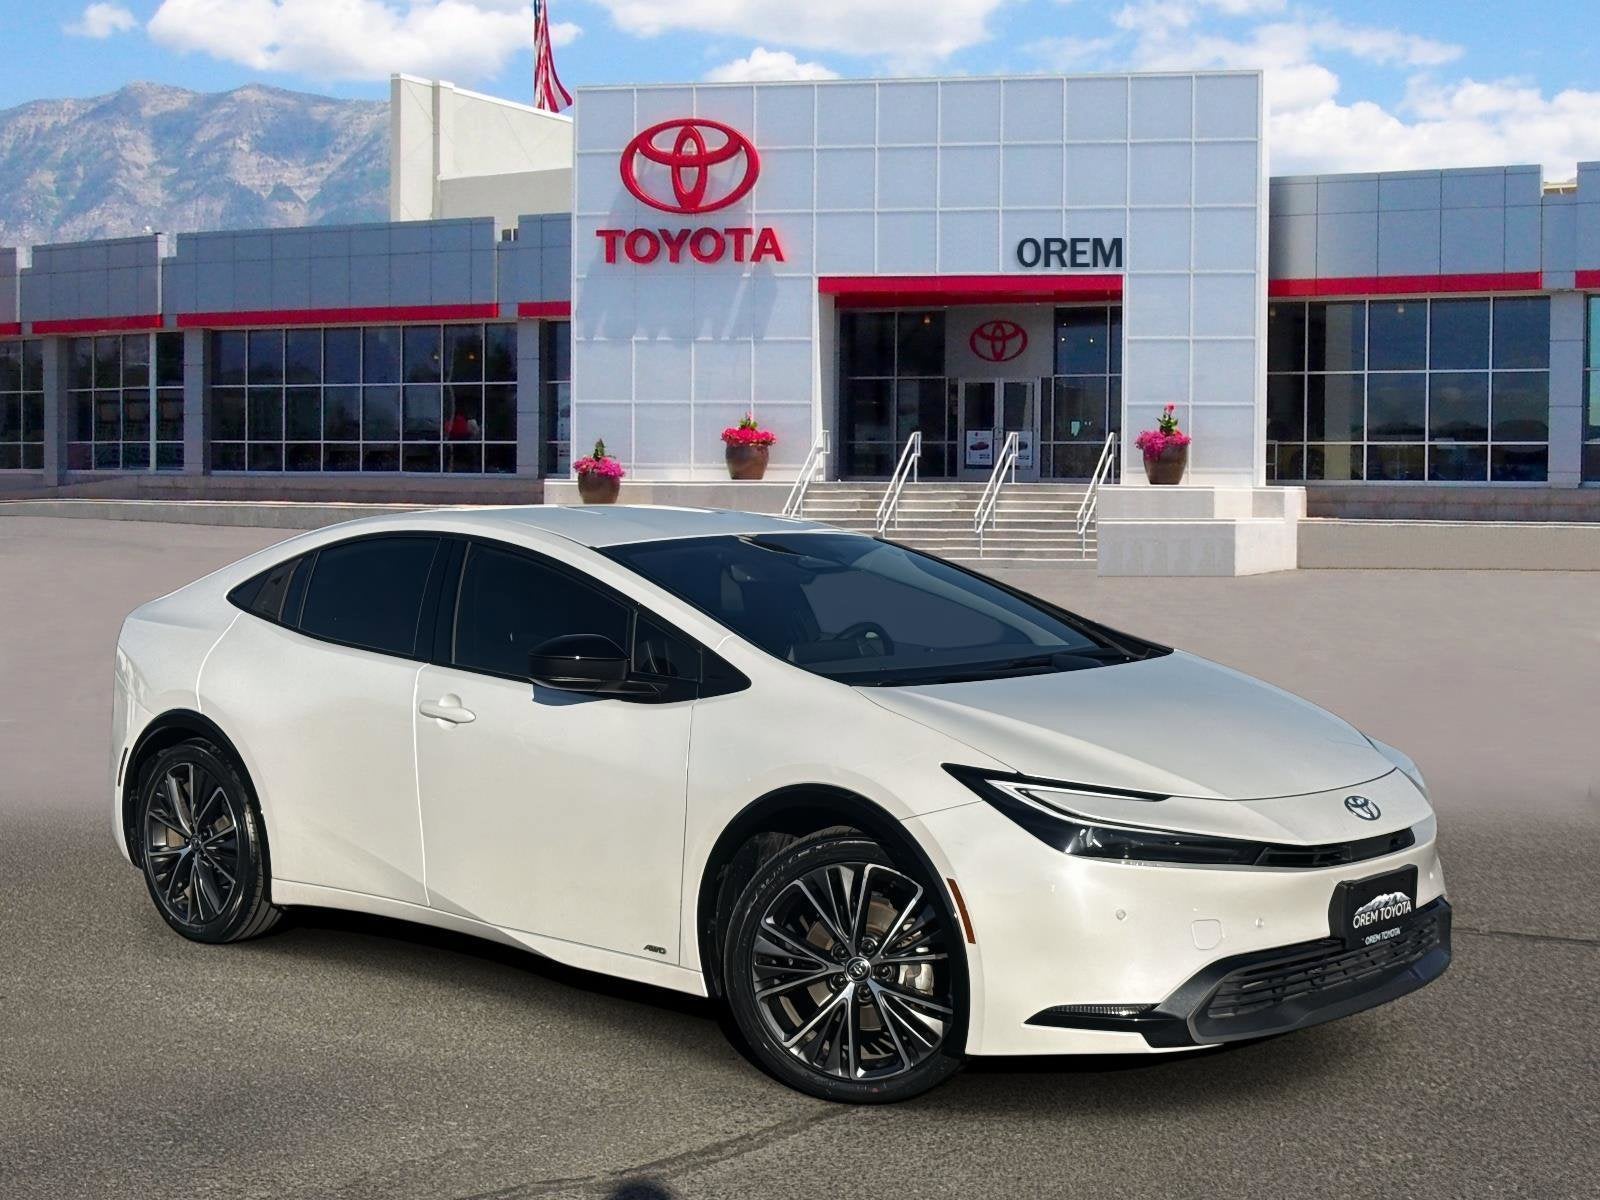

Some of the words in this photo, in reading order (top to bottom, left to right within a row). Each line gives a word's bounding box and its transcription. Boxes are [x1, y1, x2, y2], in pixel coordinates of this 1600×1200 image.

[596, 227, 785, 264] TOYOTA
[1017, 237, 1123, 268] OREM
[1353, 910, 1379, 929] OREM
[1379, 900, 1412, 921] TOYOTA
[1364, 933, 1381, 945] OREM
[1381, 927, 1401, 940] TOYOTA
